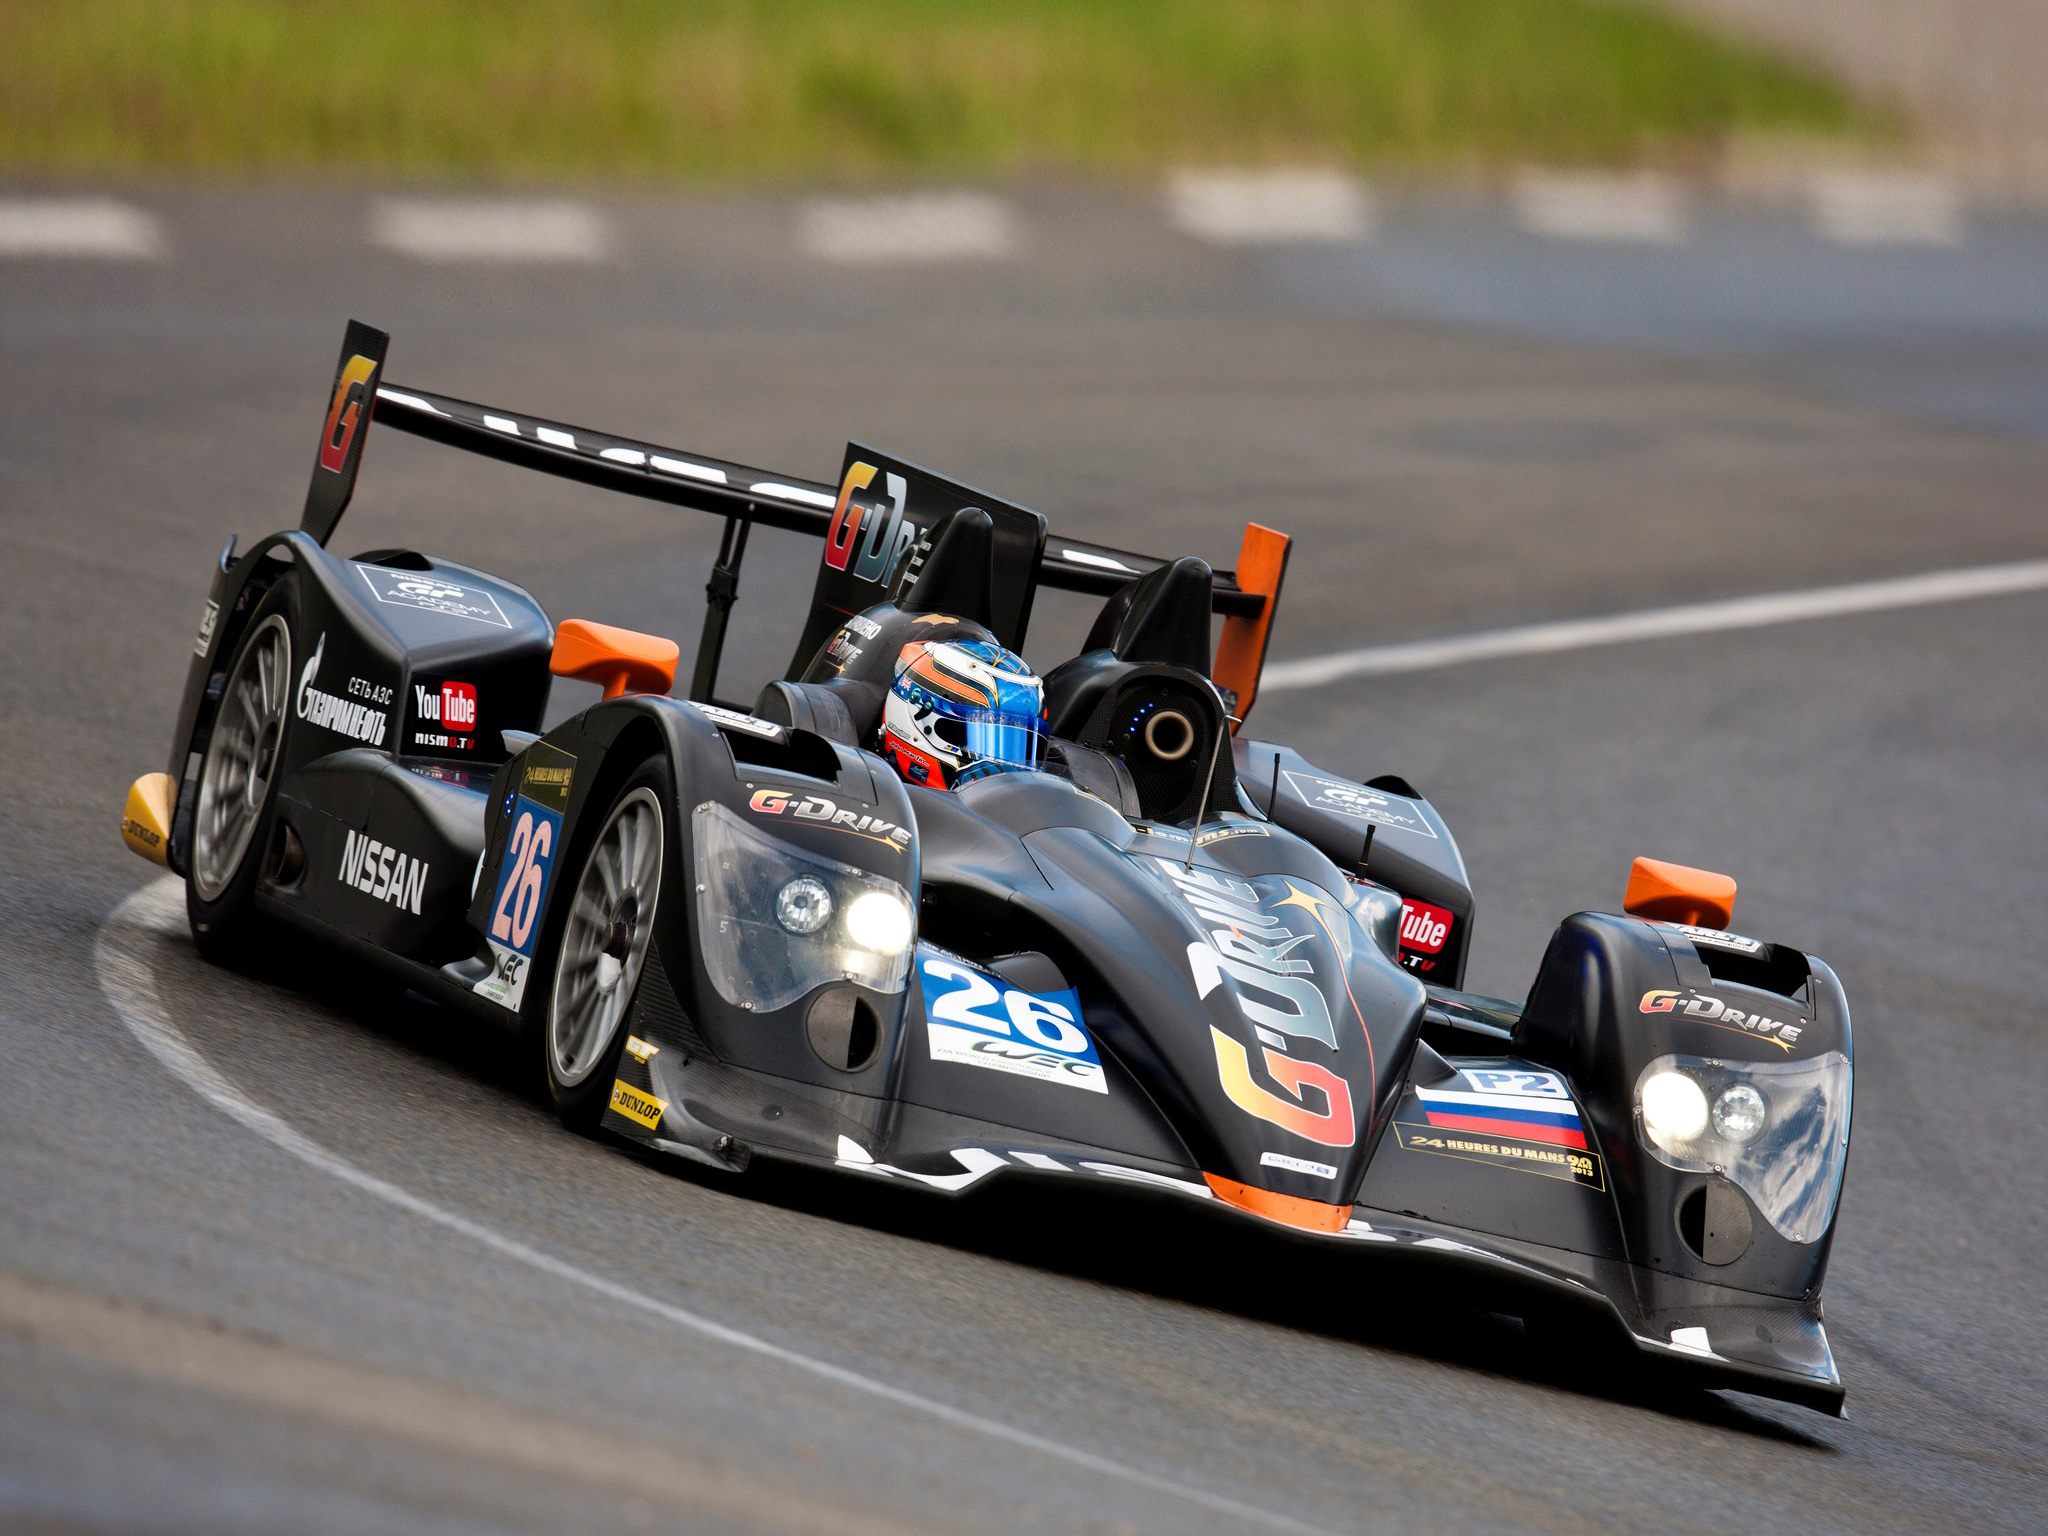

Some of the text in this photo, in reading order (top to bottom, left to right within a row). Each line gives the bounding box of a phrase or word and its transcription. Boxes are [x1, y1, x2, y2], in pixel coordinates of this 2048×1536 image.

[387, 590, 491, 615] ACADEMY
[348, 677, 393, 705] СЕТЬ АЗС
[1315, 796, 1416, 824] ACADEMY
[338, 829, 429, 915] NISSAN
[491, 811, 552, 949] 26
[924, 960, 1088, 1053] 26
[1472, 1072, 1557, 1093] P2
[619, 1092, 661, 1119] DUNLOP
[1409, 1136, 1445, 1149] 24
[1446, 1139, 1499, 1154] HEURES
[1501, 1145, 1522, 1157] DU
[1524, 1149, 1566, 1163] MANS
[1570, 1166, 1594, 1177] 2013
